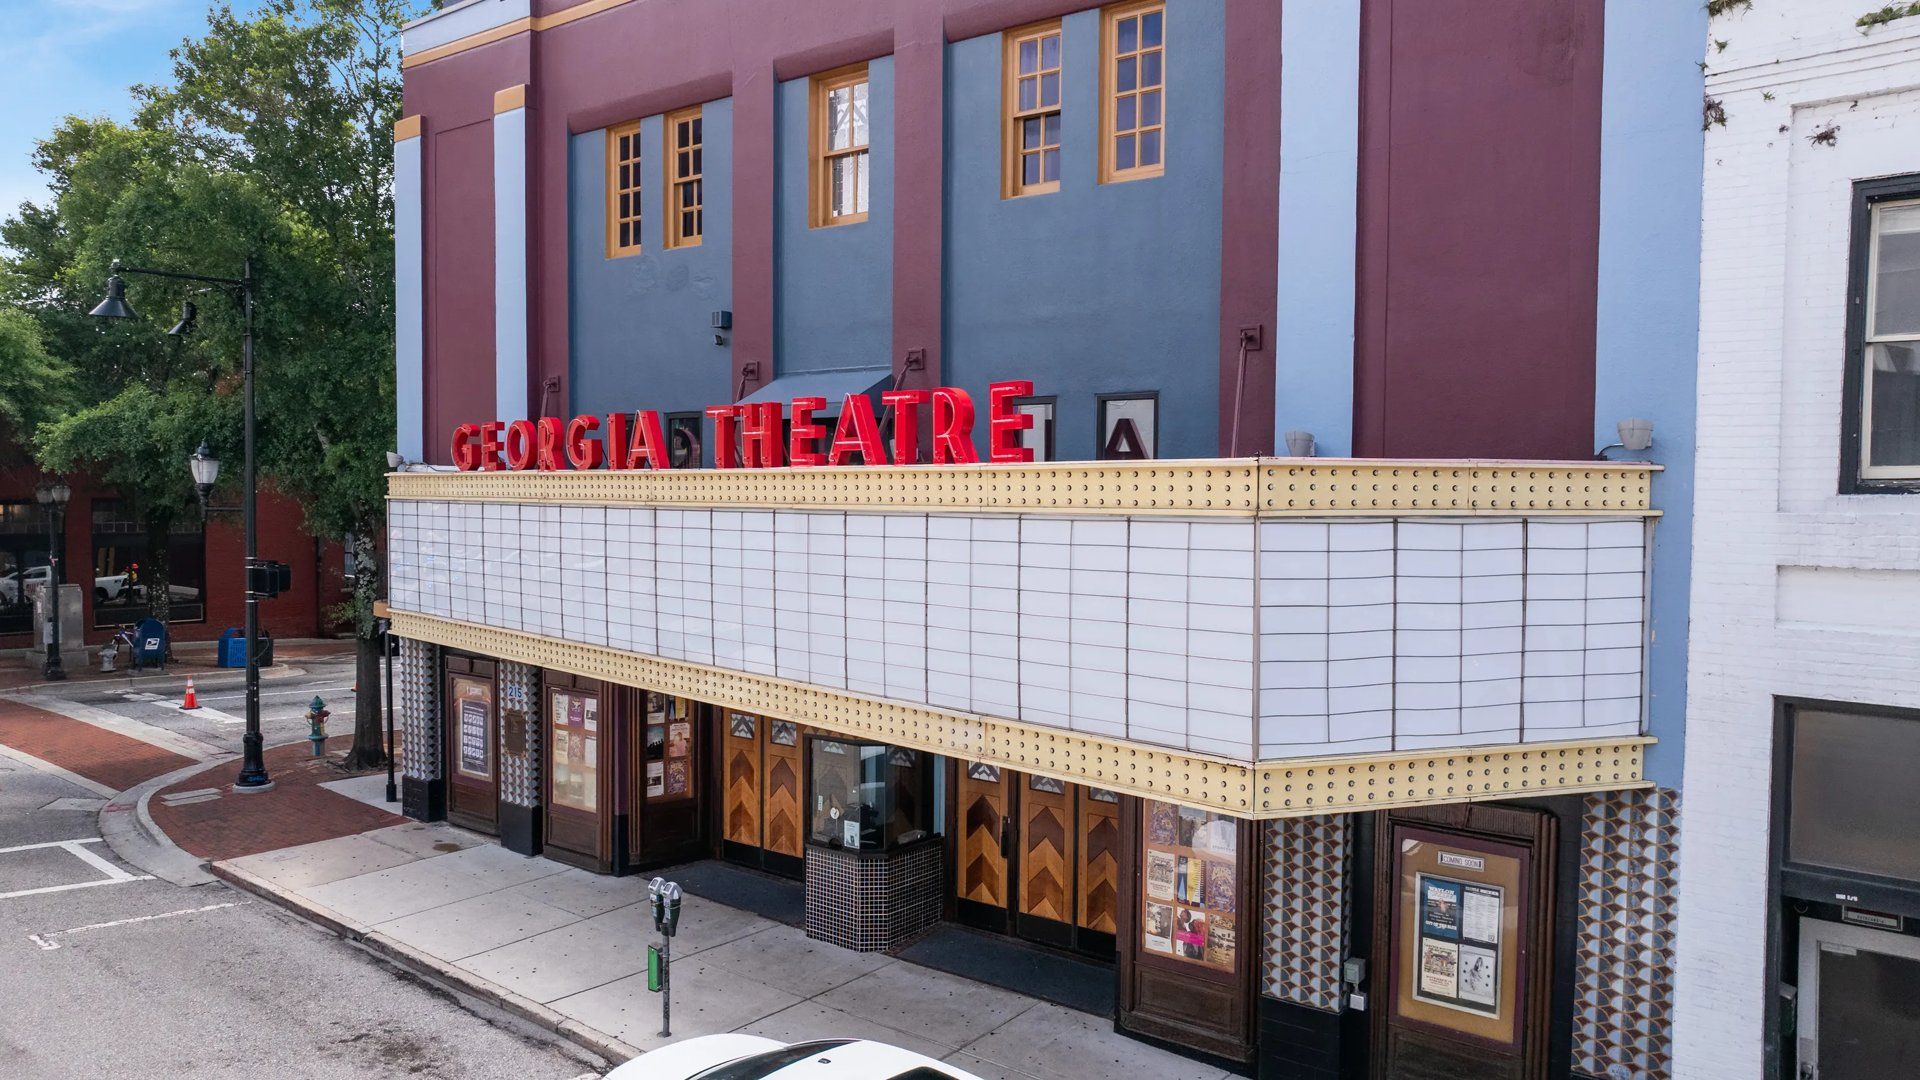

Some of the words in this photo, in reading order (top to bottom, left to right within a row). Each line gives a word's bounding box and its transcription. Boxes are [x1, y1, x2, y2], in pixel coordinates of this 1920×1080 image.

[451, 409, 671, 471] GEORGIA
[705, 381, 1034, 469] THEATRE
[508, 687, 523, 698] 215
[1443, 855, 1463, 865] COMING
[1464, 859, 1479, 868] SOON
